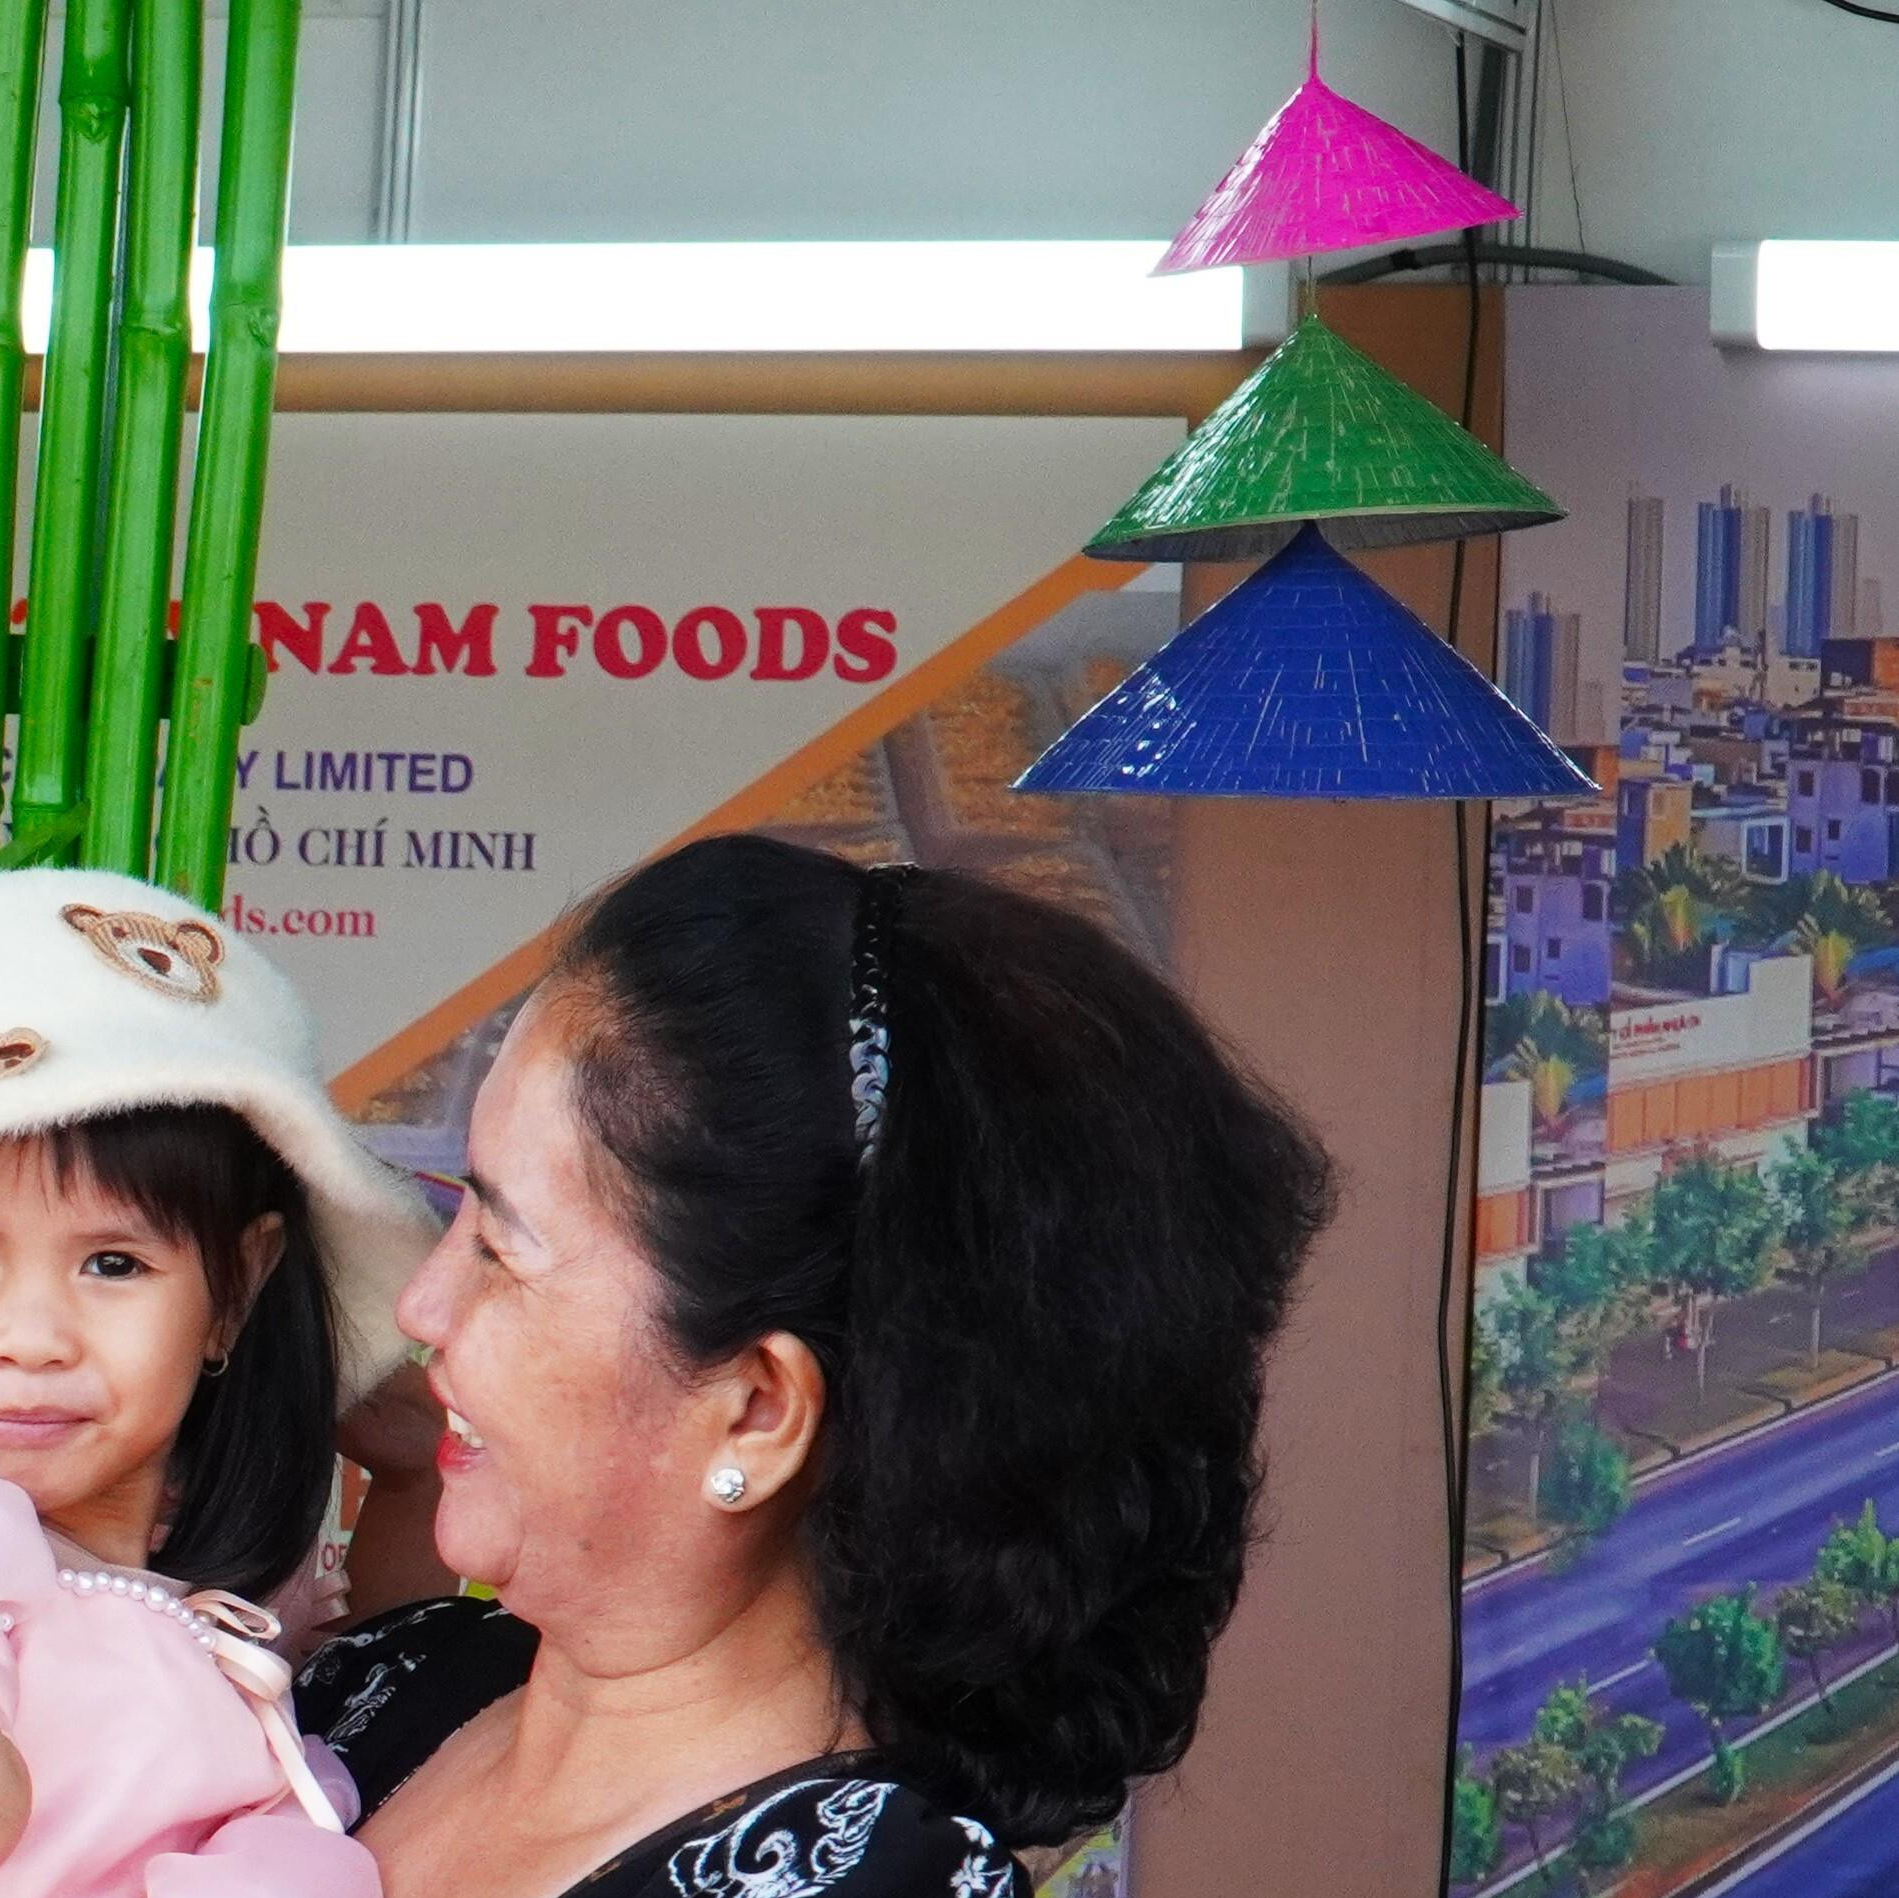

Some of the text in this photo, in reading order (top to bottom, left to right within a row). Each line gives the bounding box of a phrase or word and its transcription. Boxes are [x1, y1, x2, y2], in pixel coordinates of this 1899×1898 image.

[252, 600, 500, 678] NAM
[524, 603, 897, 684] FOODS
[275, 750, 474, 794] LIMITED
[297, 816, 389, 868] CHÍ
[403, 829, 538, 872] MINH
